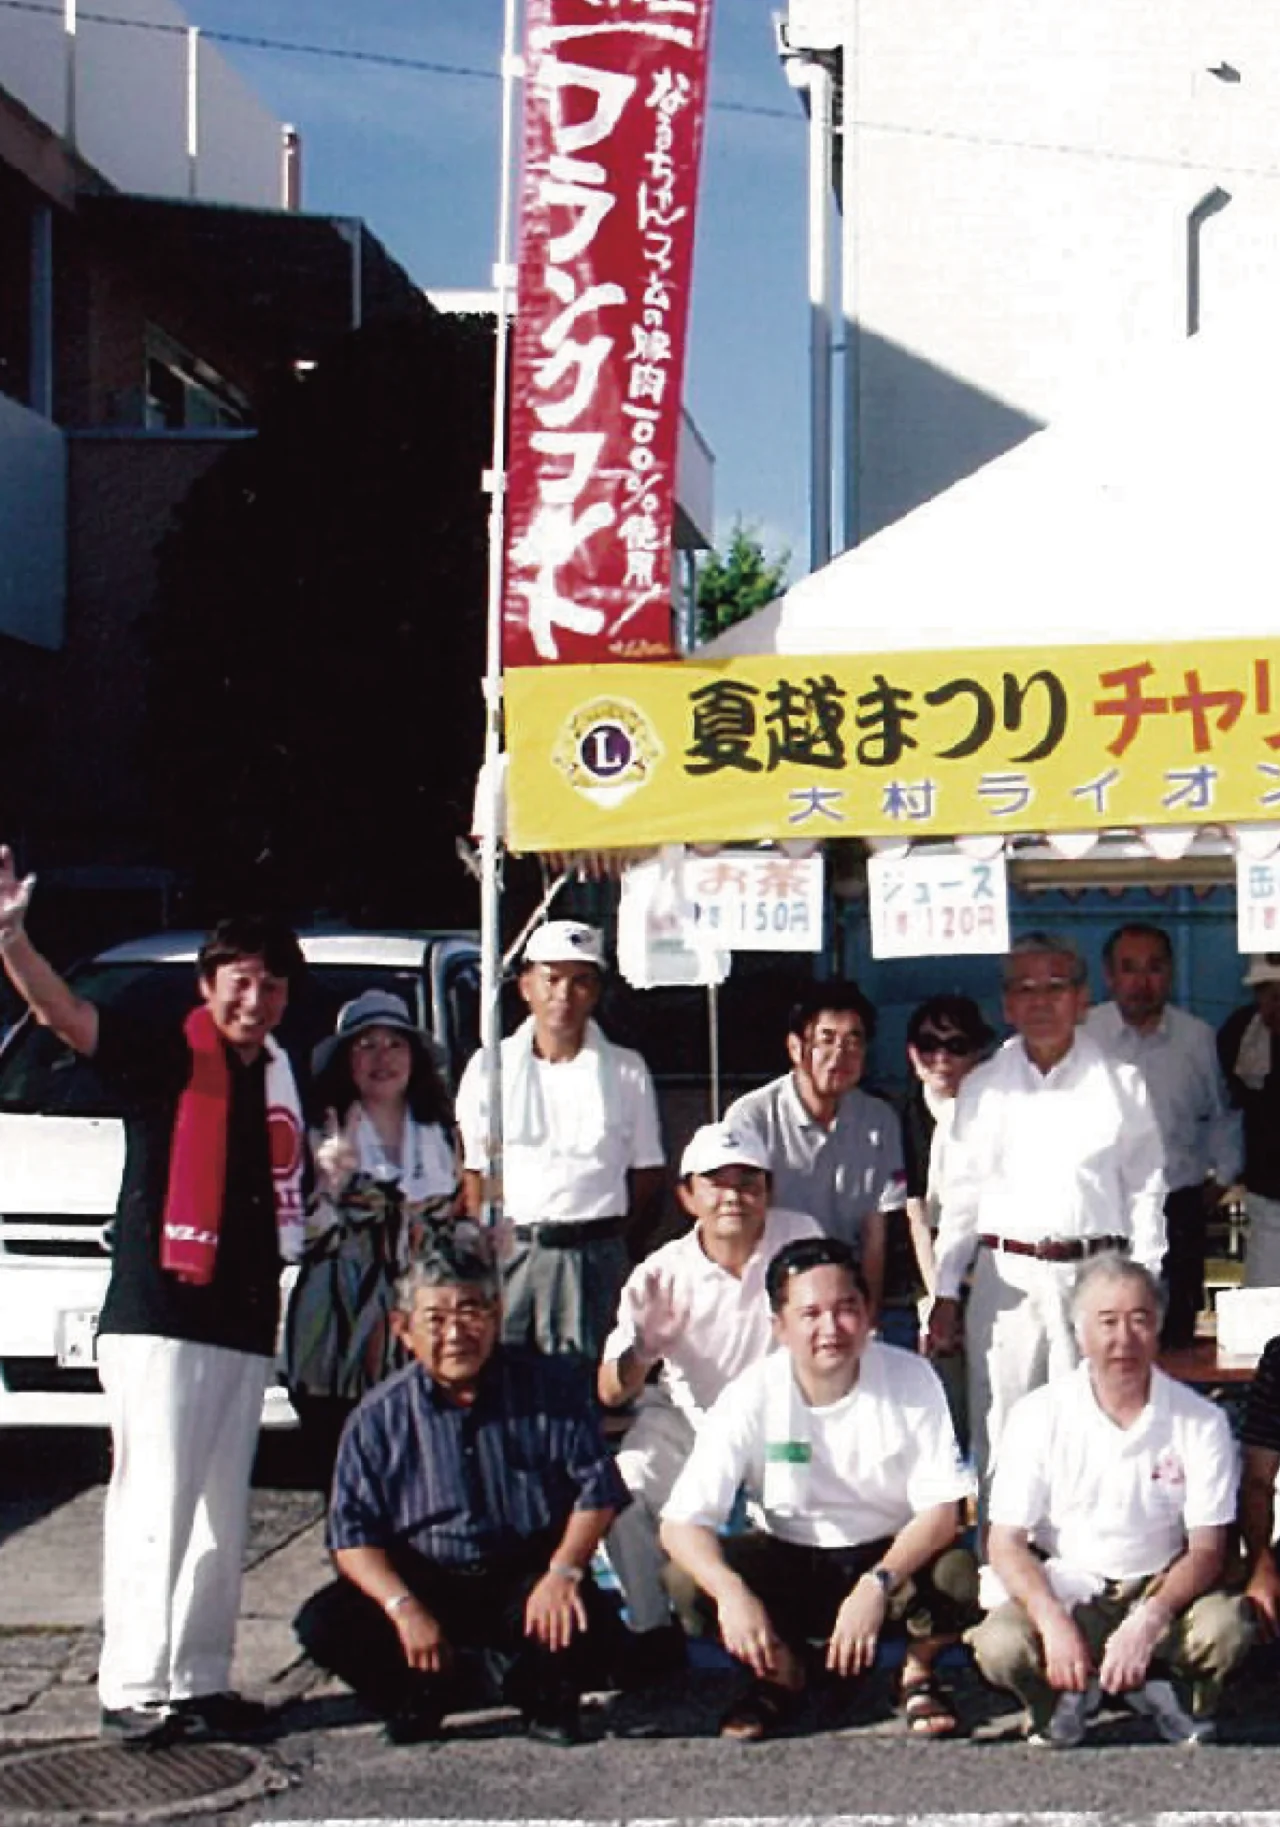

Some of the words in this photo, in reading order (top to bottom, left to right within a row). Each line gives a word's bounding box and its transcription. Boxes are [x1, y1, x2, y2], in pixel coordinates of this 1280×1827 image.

[681, 669, 1068, 774] 夏越まつり
[593, 731, 622, 768] L
[697, 861, 811, 898] お茶
[882, 865, 995, 904] ジュース
[739, 901, 810, 932] 150円
[926, 904, 995, 939] 120円
